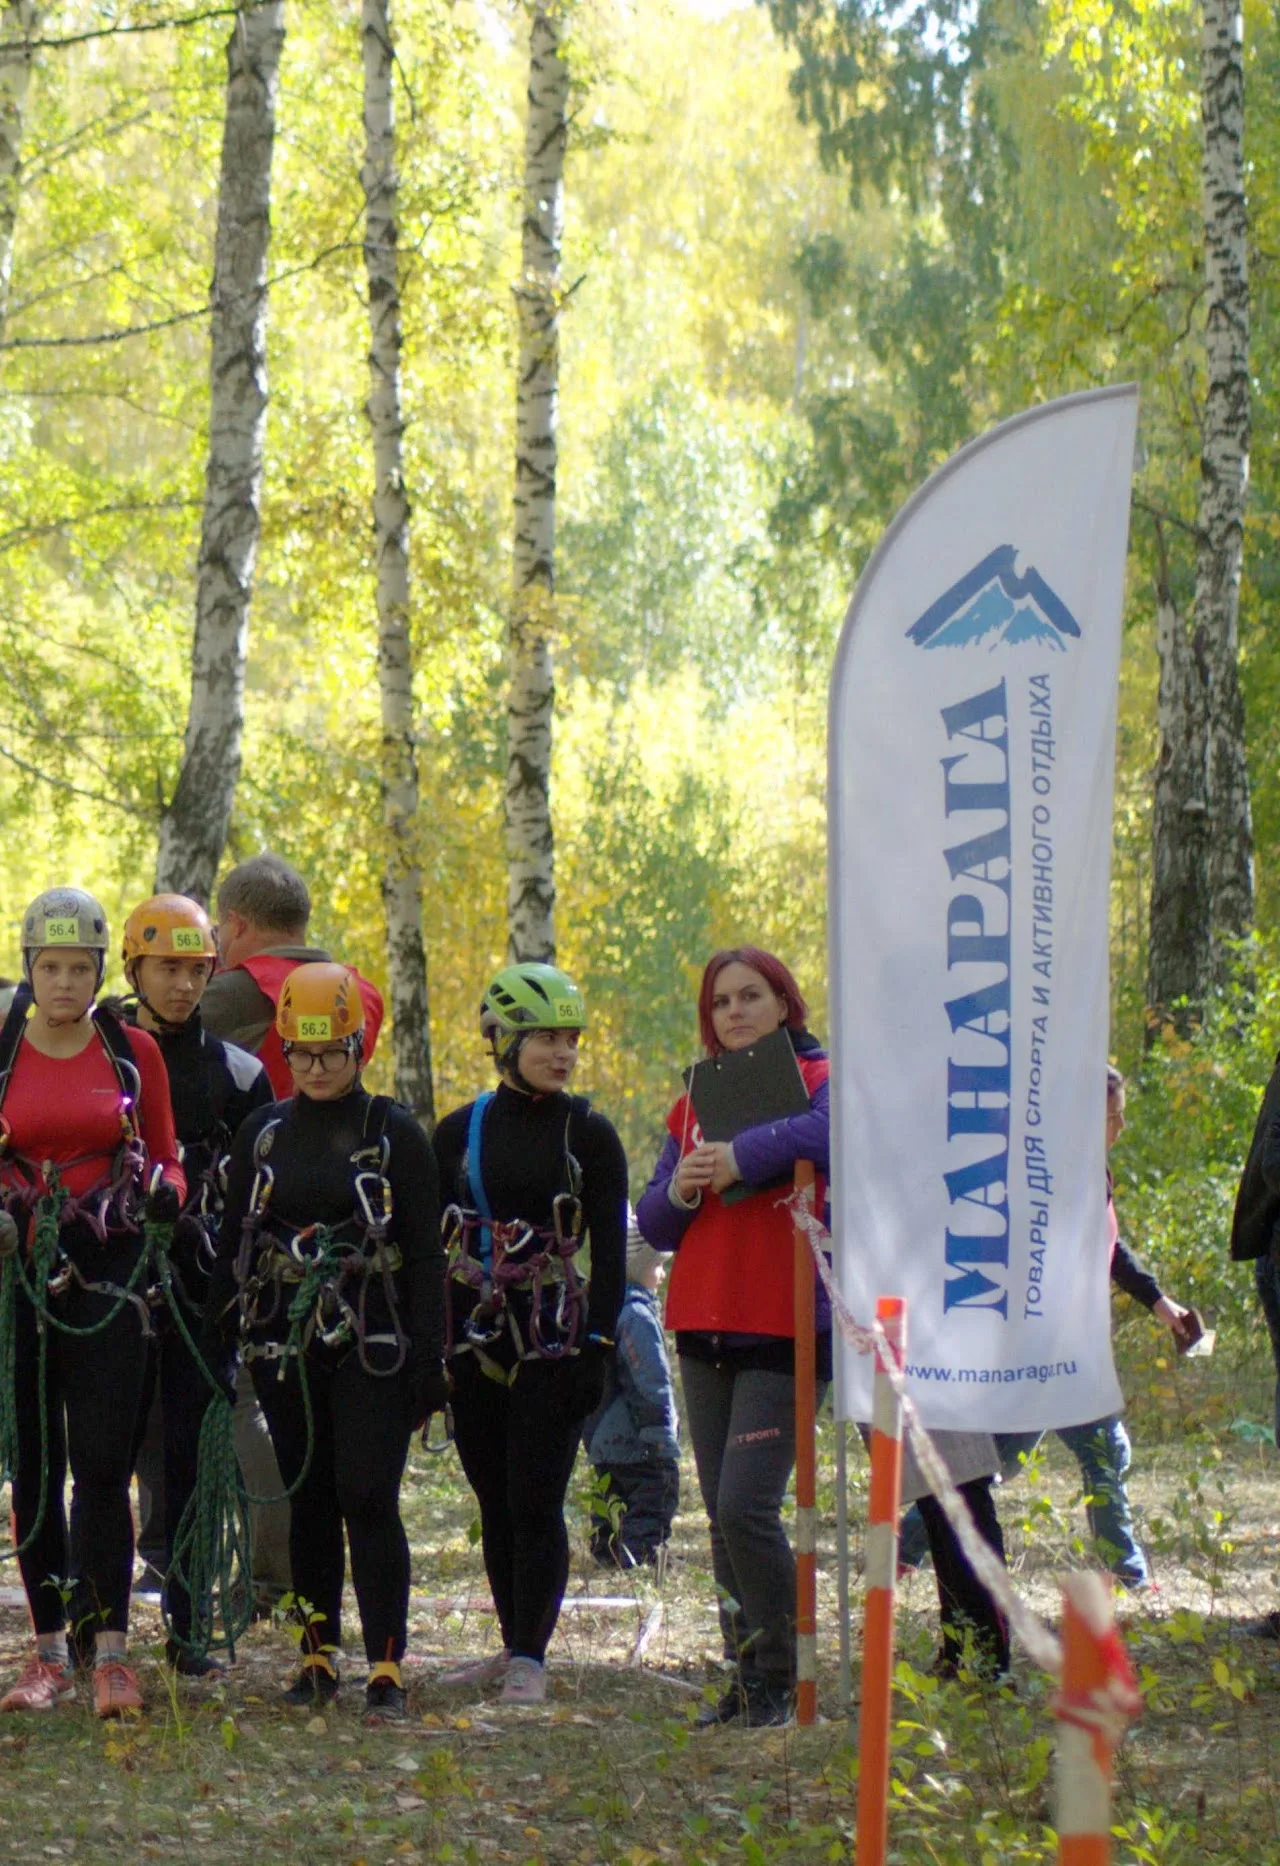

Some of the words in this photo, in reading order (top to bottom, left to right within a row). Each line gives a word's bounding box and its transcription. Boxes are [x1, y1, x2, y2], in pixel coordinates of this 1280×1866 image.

[1028, 672, 1056, 796] ОТДЫХА
[49, 923, 76, 937] 56.4
[1032, 804, 1054, 979] АКТИВНОГО
[176, 935, 202, 947] 56.3
[301, 1022, 329, 1036] 56.2
[939, 675, 1012, 1322] МАНАРАГА
[1031, 985, 1051, 1007] И
[1026, 1015, 1048, 1126] СПОРТА
[1024, 1135, 1054, 1195] ДЛЯ
[1024, 1200, 1049, 1321] ТОВАРЫ
